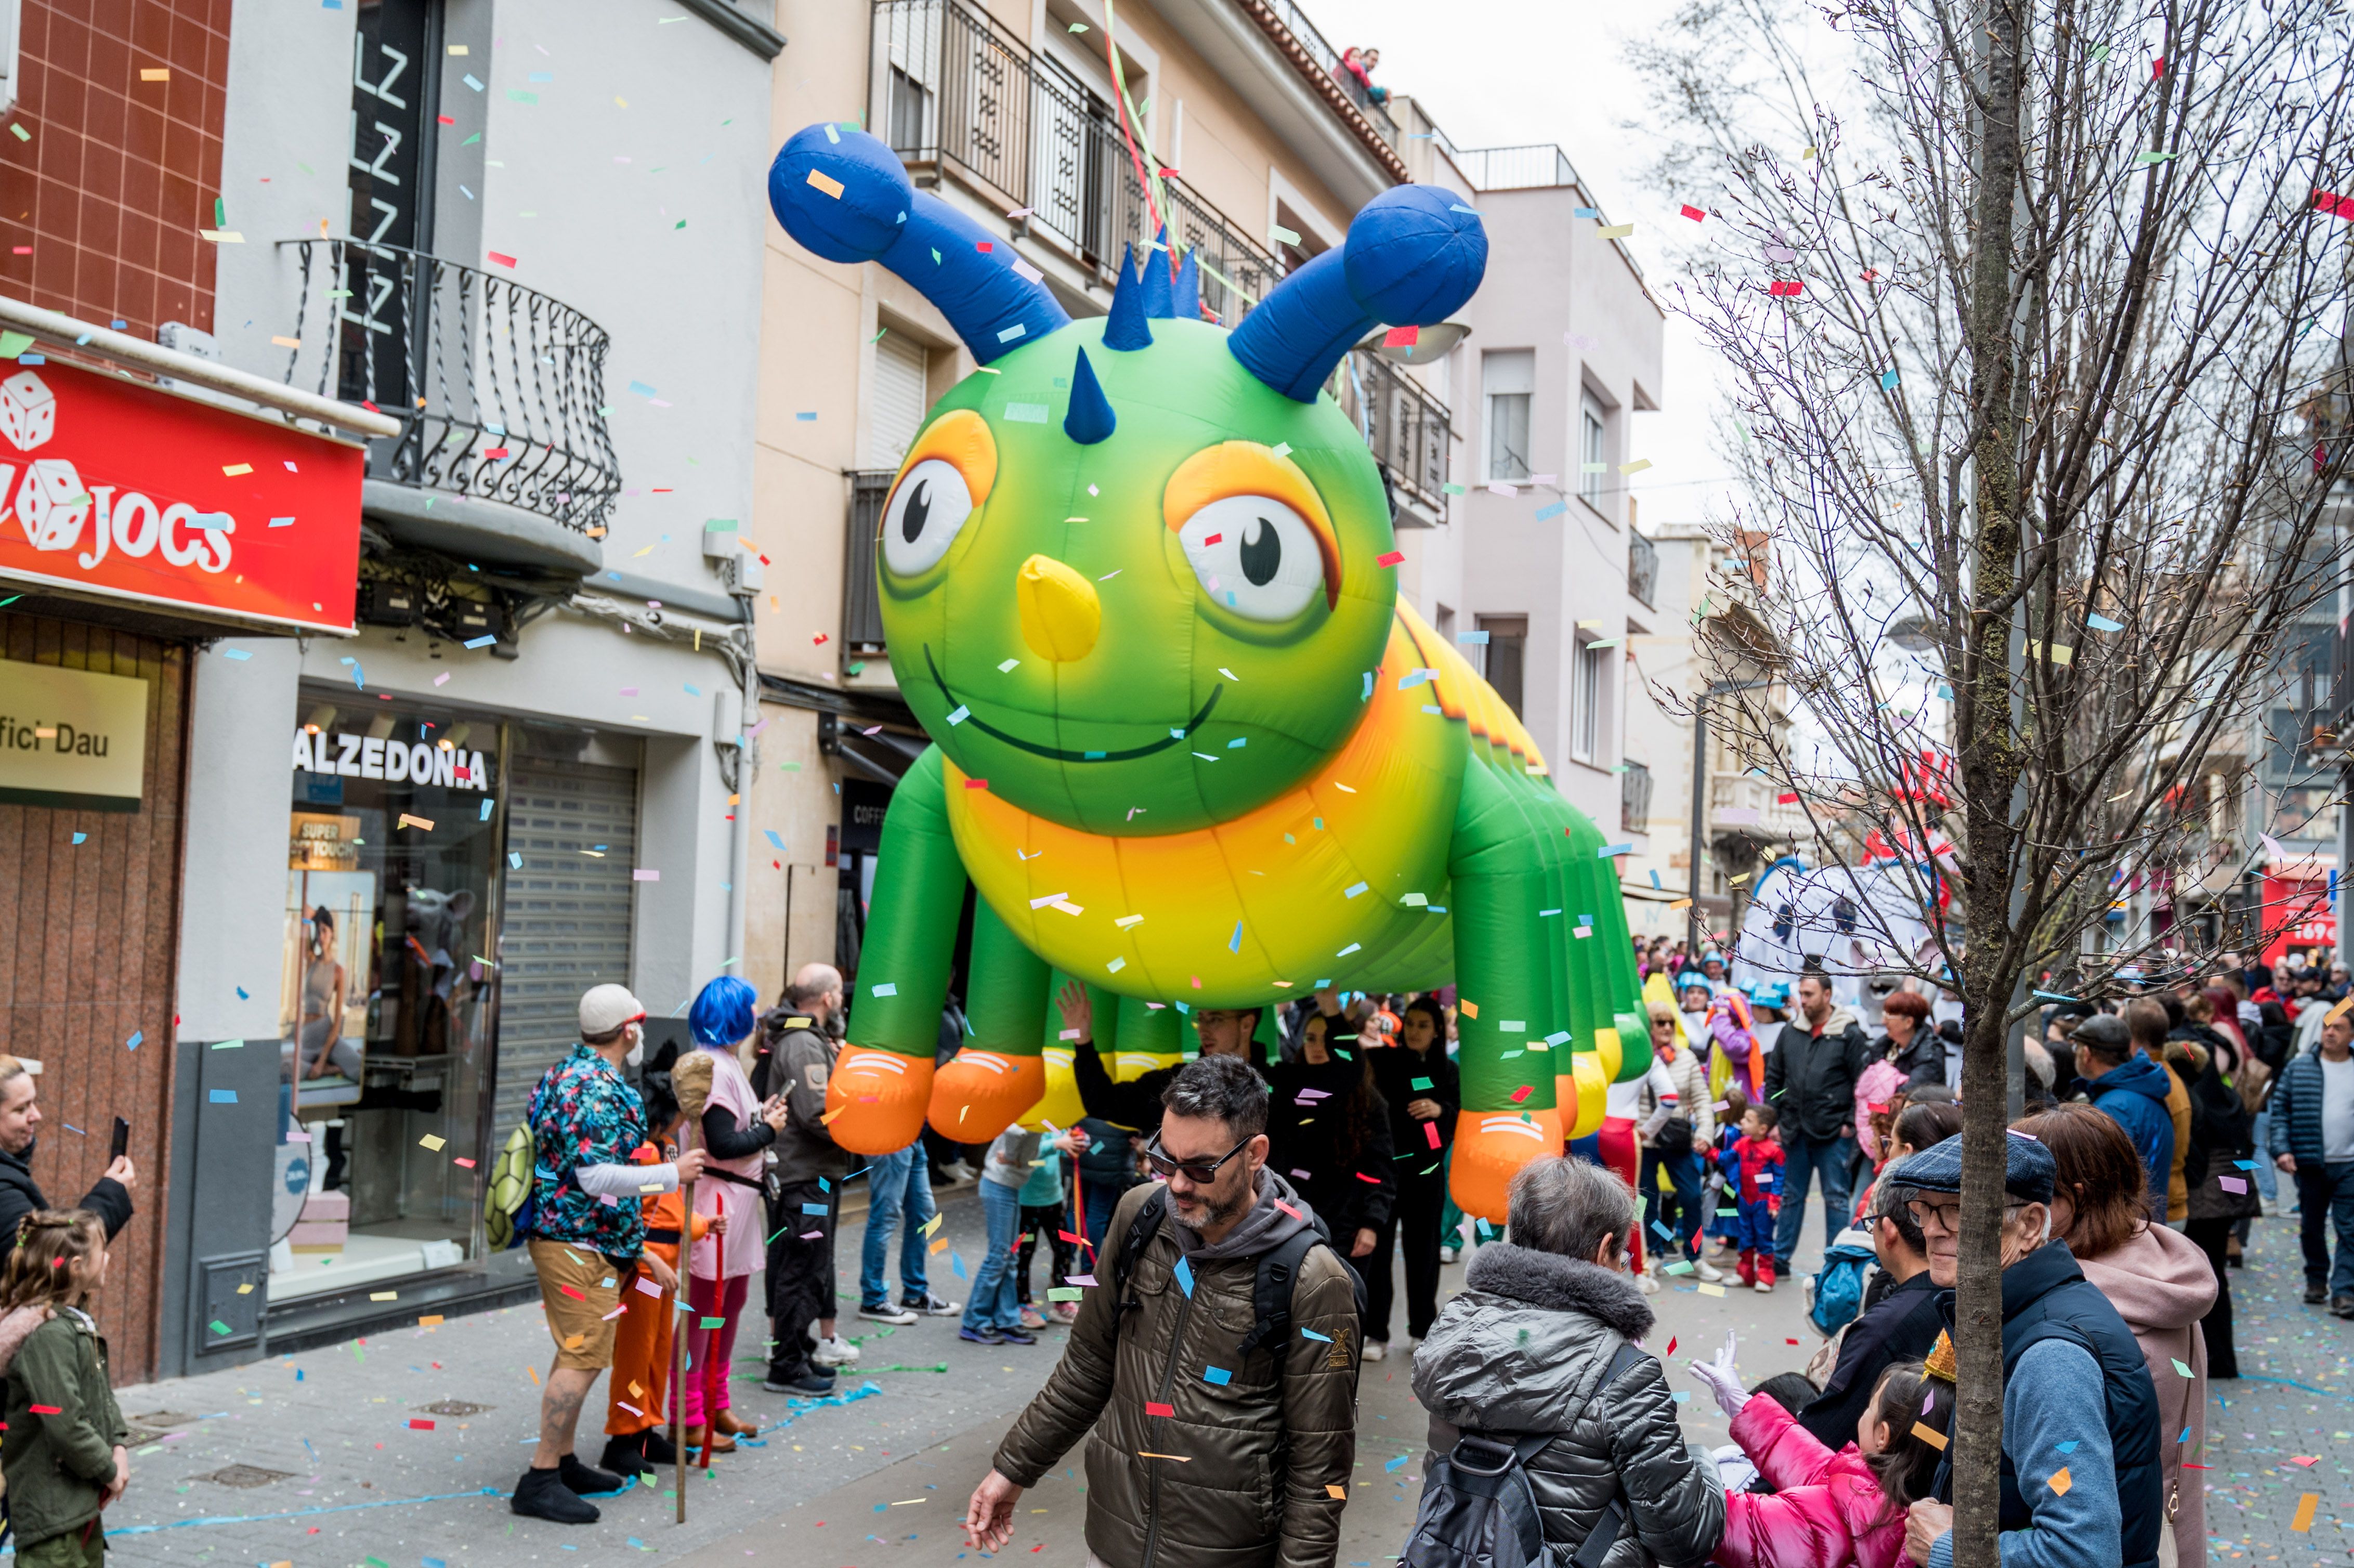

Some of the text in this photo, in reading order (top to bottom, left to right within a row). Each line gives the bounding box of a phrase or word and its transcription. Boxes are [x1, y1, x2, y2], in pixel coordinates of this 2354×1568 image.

[56, 722, 108, 757] Dau
[302, 822, 339, 840] SUPER
[313, 841, 355, 858] TOUCH
